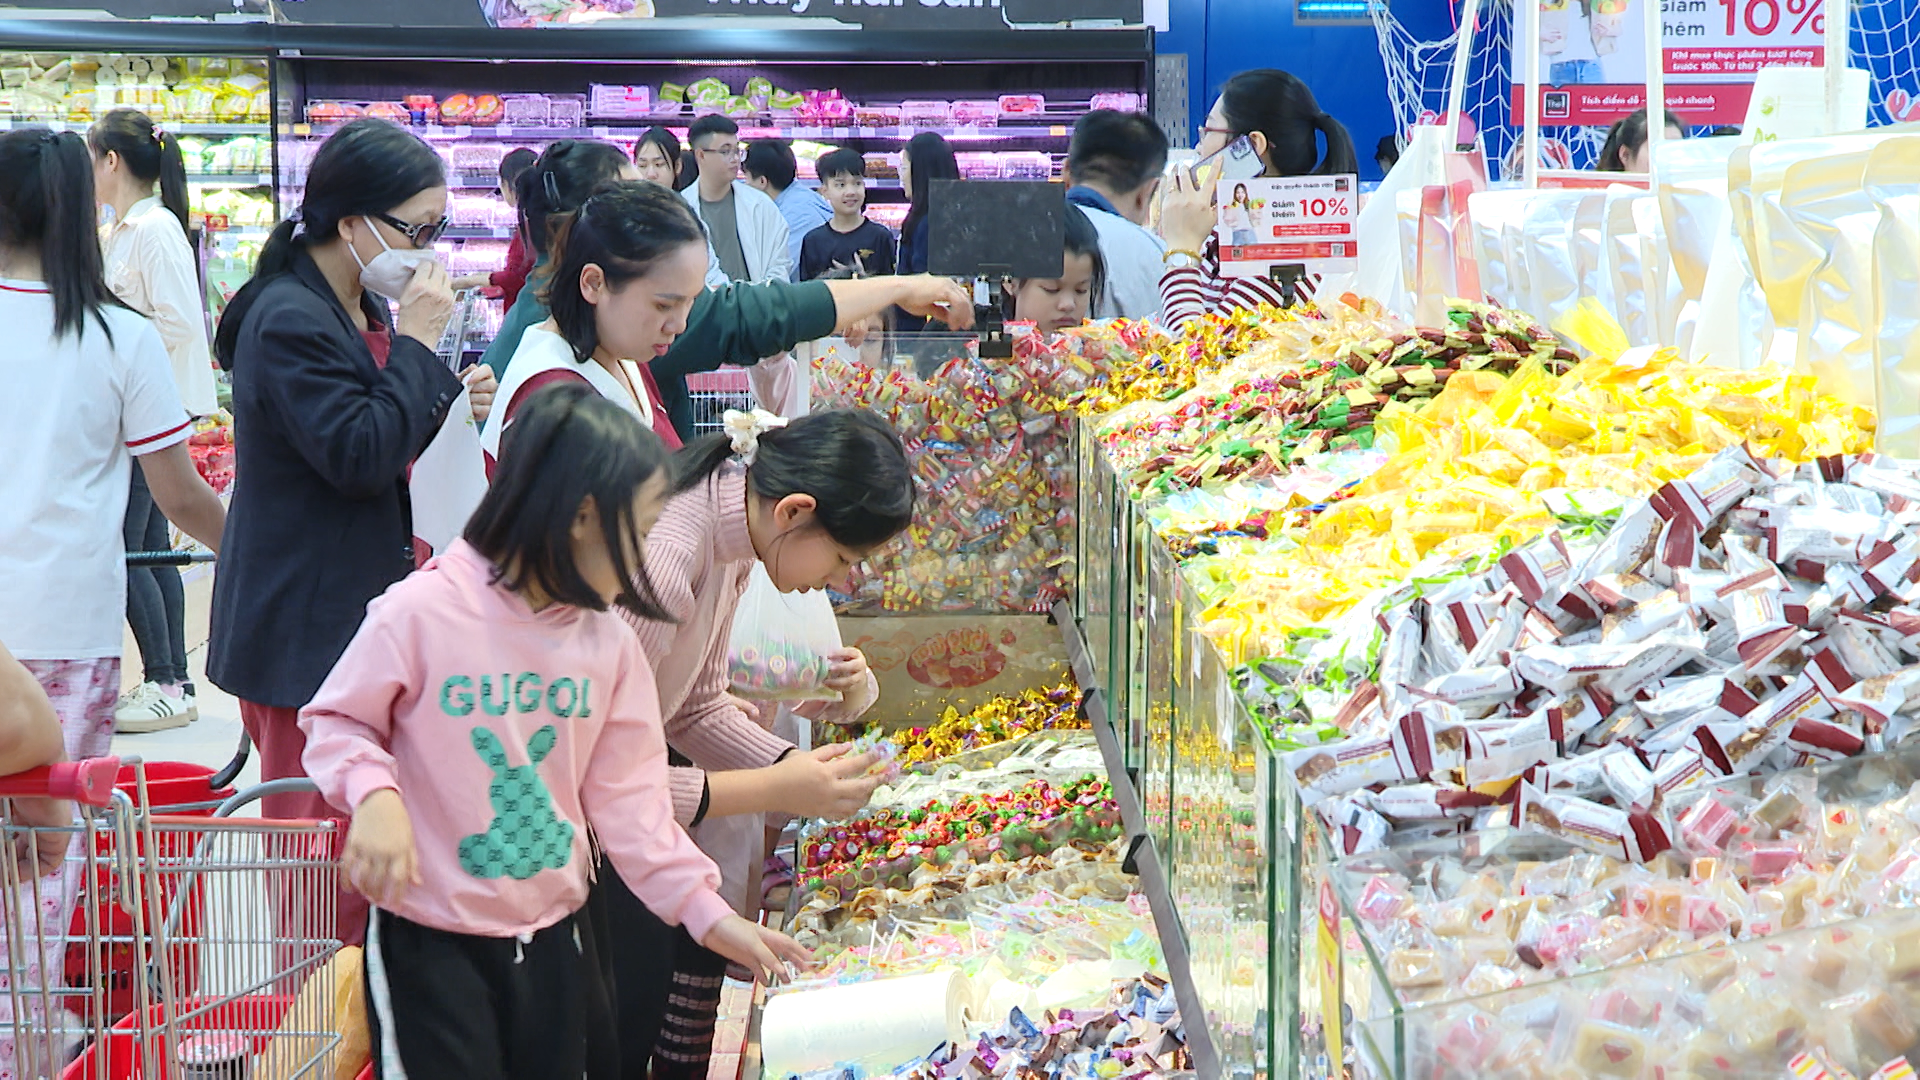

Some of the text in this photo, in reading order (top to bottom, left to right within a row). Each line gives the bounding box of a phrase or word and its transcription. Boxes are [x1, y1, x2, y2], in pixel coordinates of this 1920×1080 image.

[1719, 0, 1825, 36] 10%
[1663, 21, 1706, 36] hêm
[1672, 51, 1689, 60] Khi
[1299, 197, 1349, 217] 10%
